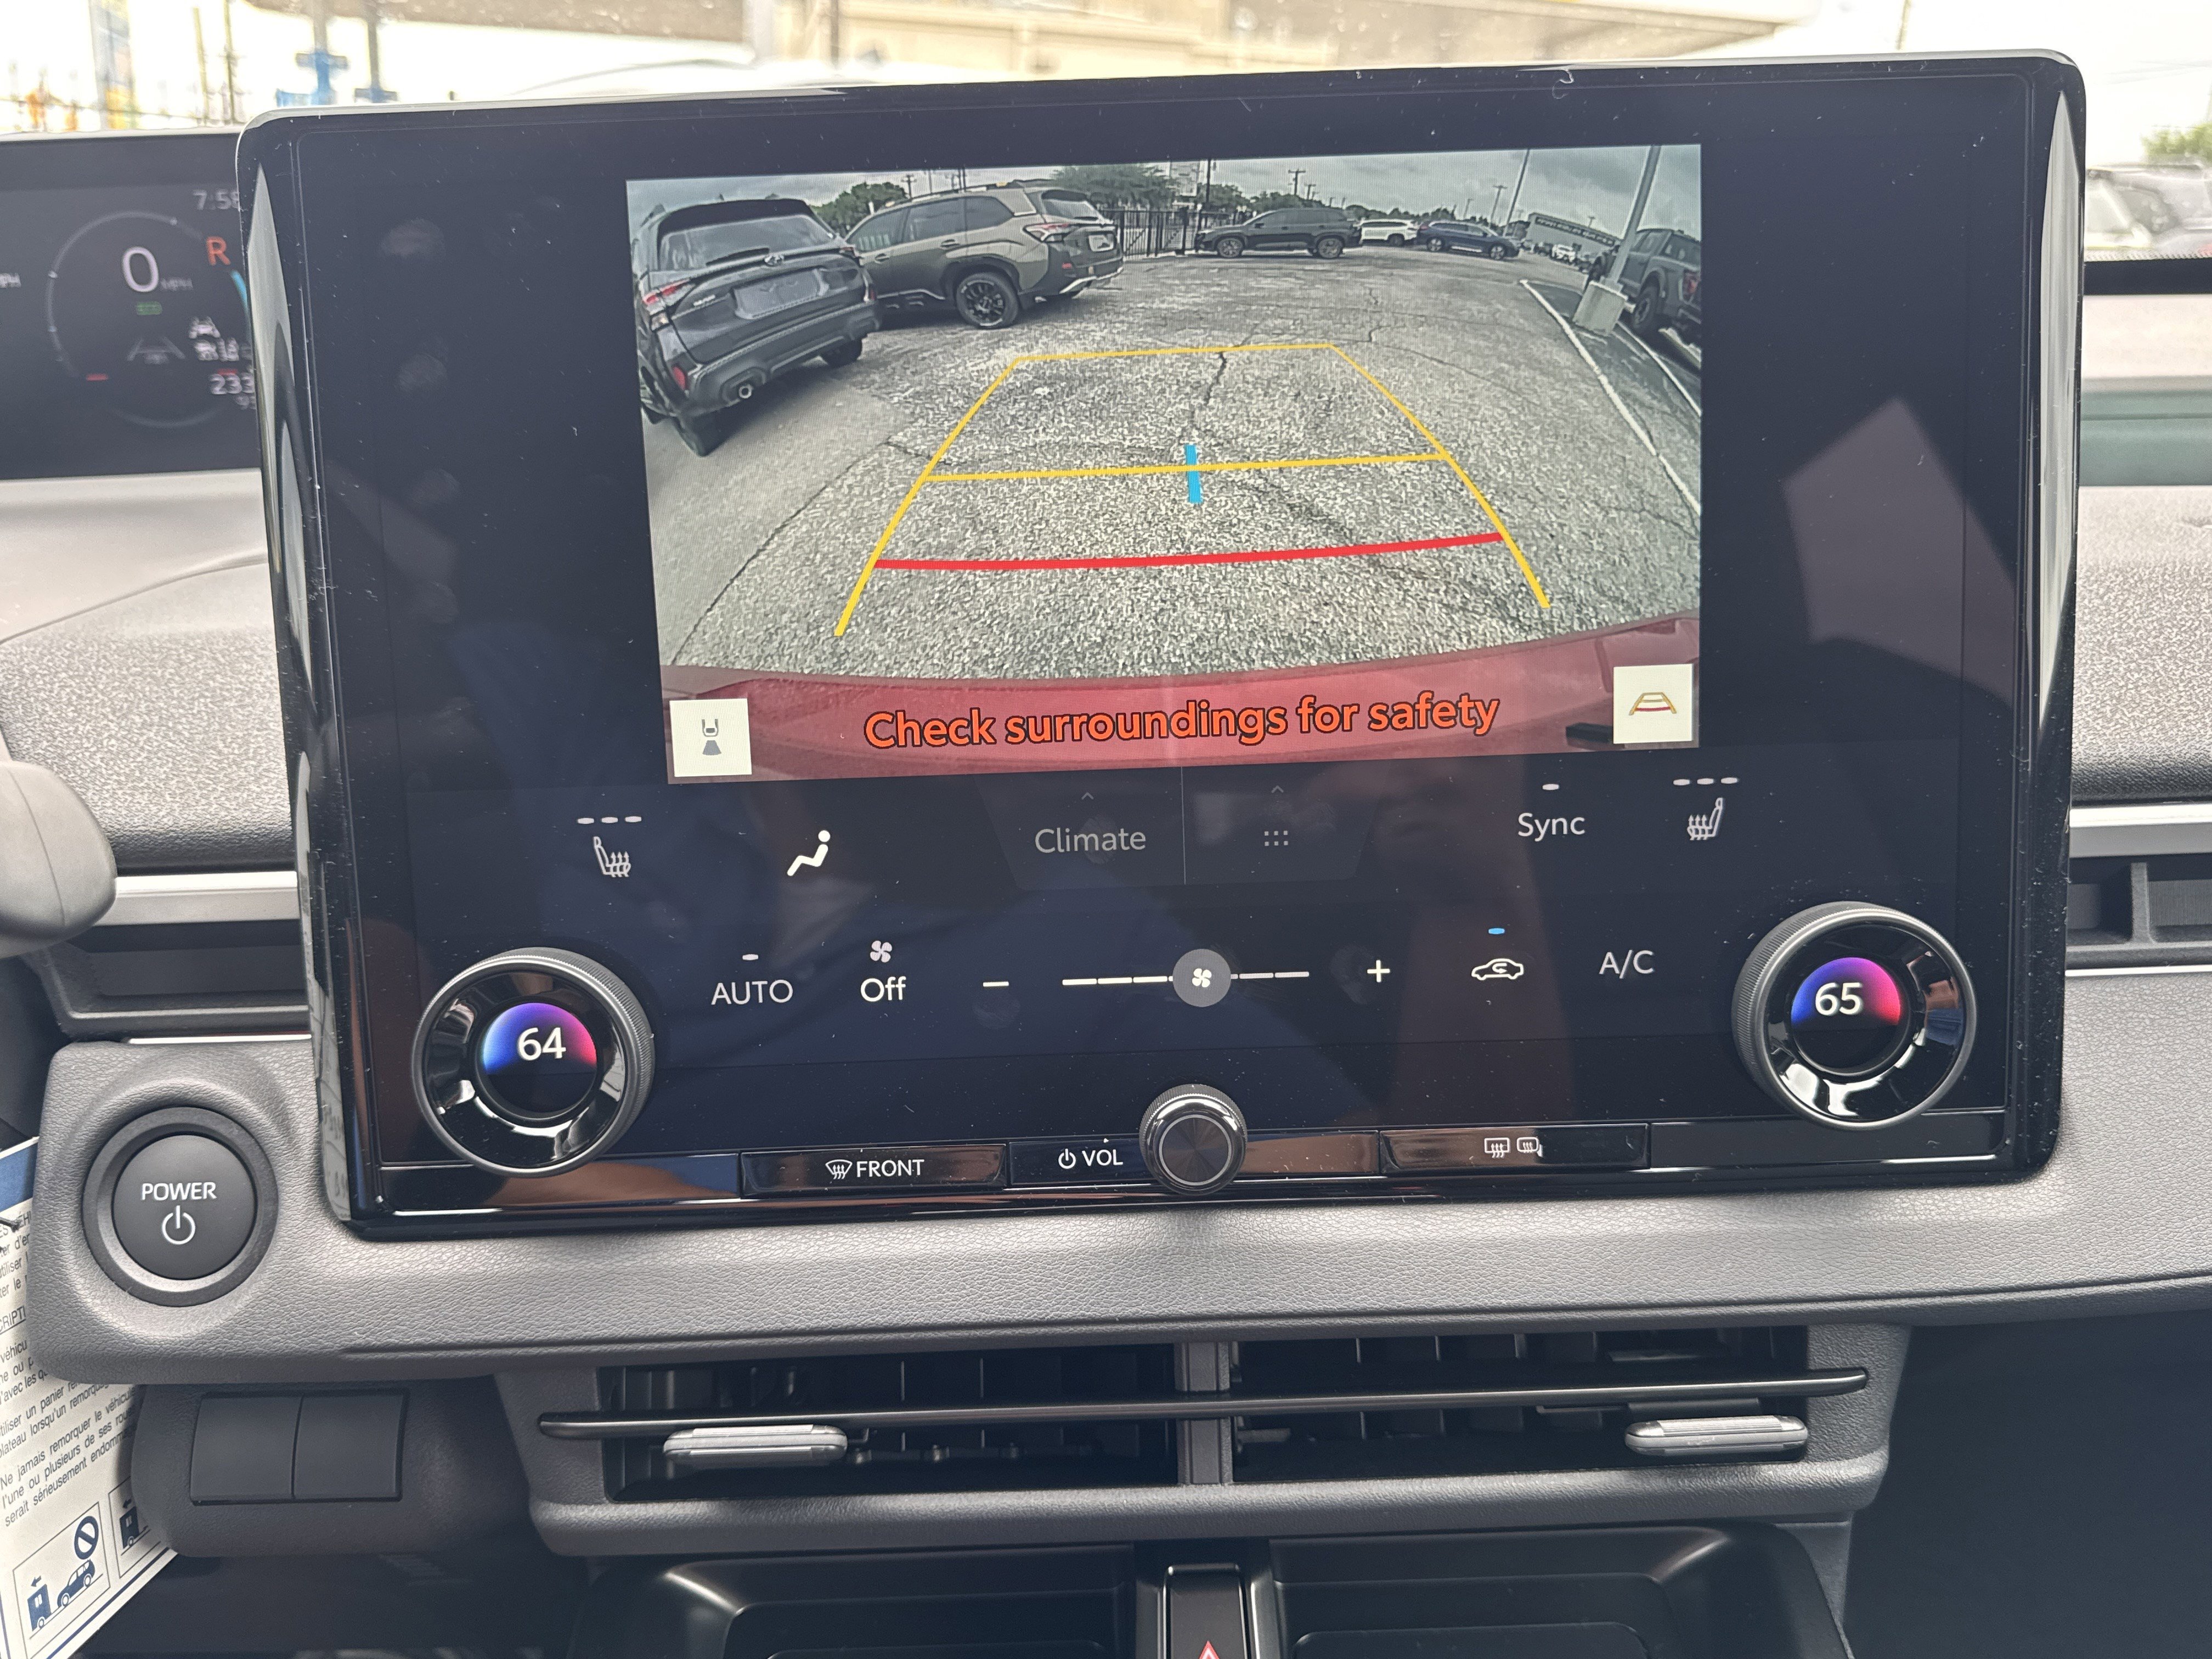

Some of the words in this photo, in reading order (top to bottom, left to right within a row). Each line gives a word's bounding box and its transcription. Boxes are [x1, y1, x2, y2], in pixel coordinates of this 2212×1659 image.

[206, 236, 231, 266] R
[122, 246, 159, 292] 0
[864, 708, 995, 749] Check
[1005, 700, 1288, 746] surroundings
[1296, 695, 1359, 733] for
[1368, 690, 1499, 736] safety
[1034, 826, 1147, 854] Climate
[1517, 812, 1586, 842] Sync
[1598, 949, 1655, 979] A/C
[710, 978, 794, 1006] AUTO
[860, 974, 907, 1003] Off
[1815, 981, 1863, 1016] 65
[517, 1026, 567, 1061] 64
[855, 1159, 926, 1179] FRONT
[1081, 1148, 1124, 1167] VOL
[140, 1181, 218, 1201] POWER
[13, 1278, 21, 1290] le
[13, 1362, 24, 1376] ou
[25, 1373, 37, 1389] les
[0, 1414, 21, 1437] tiliser
[26, 1405, 37, 1419] un
[40, 1386, 64, 1414] panier
[30, 1404, 66, 1436] lorsqu'un
[0, 1472, 14, 1491] Ne
[18, 1449, 46, 1482] jamais
[49, 1417, 91, 1455] remorquer
[94, 1410, 103, 1423] le
[2, 1486, 25, 1509] l'une
[29, 1474, 41, 1489] ou
[44, 1444, 81, 1481] plusieurs
[84, 1434, 95, 1448] de
[98, 1421, 112, 1438] ses
[5, 1499, 30, 1528] serait
[33, 1456, 88, 1506] sérieusement
